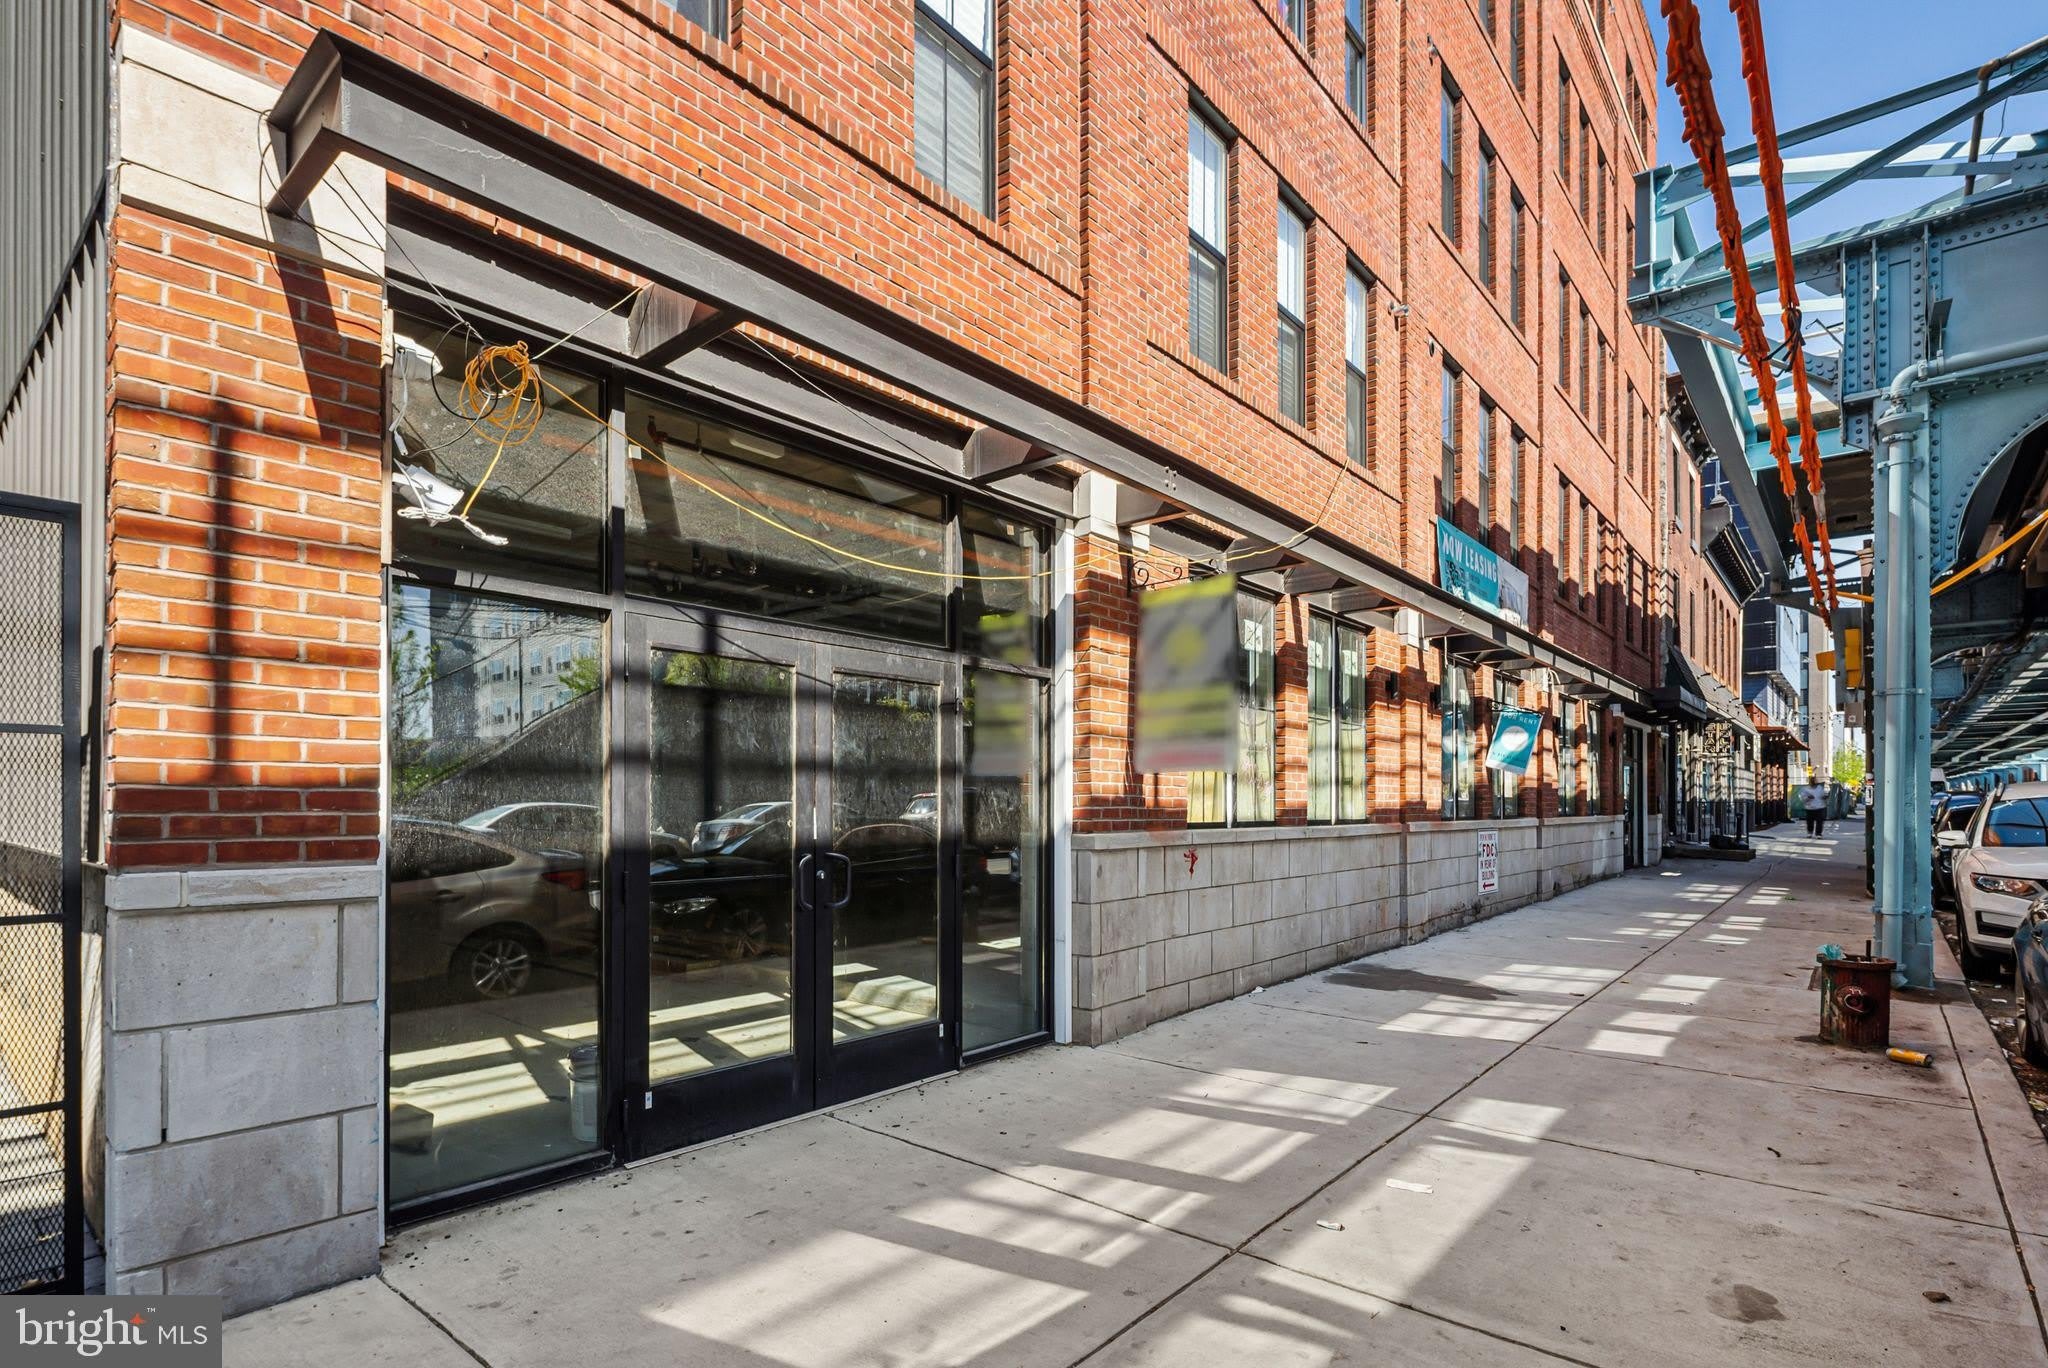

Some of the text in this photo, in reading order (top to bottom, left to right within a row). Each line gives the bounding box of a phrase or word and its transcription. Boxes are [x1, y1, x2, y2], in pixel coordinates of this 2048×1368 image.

[1442, 531, 1497, 583] NOW LEASING
[1519, 716, 1538, 725] RENT
[1482, 843, 1495, 858] FDC
